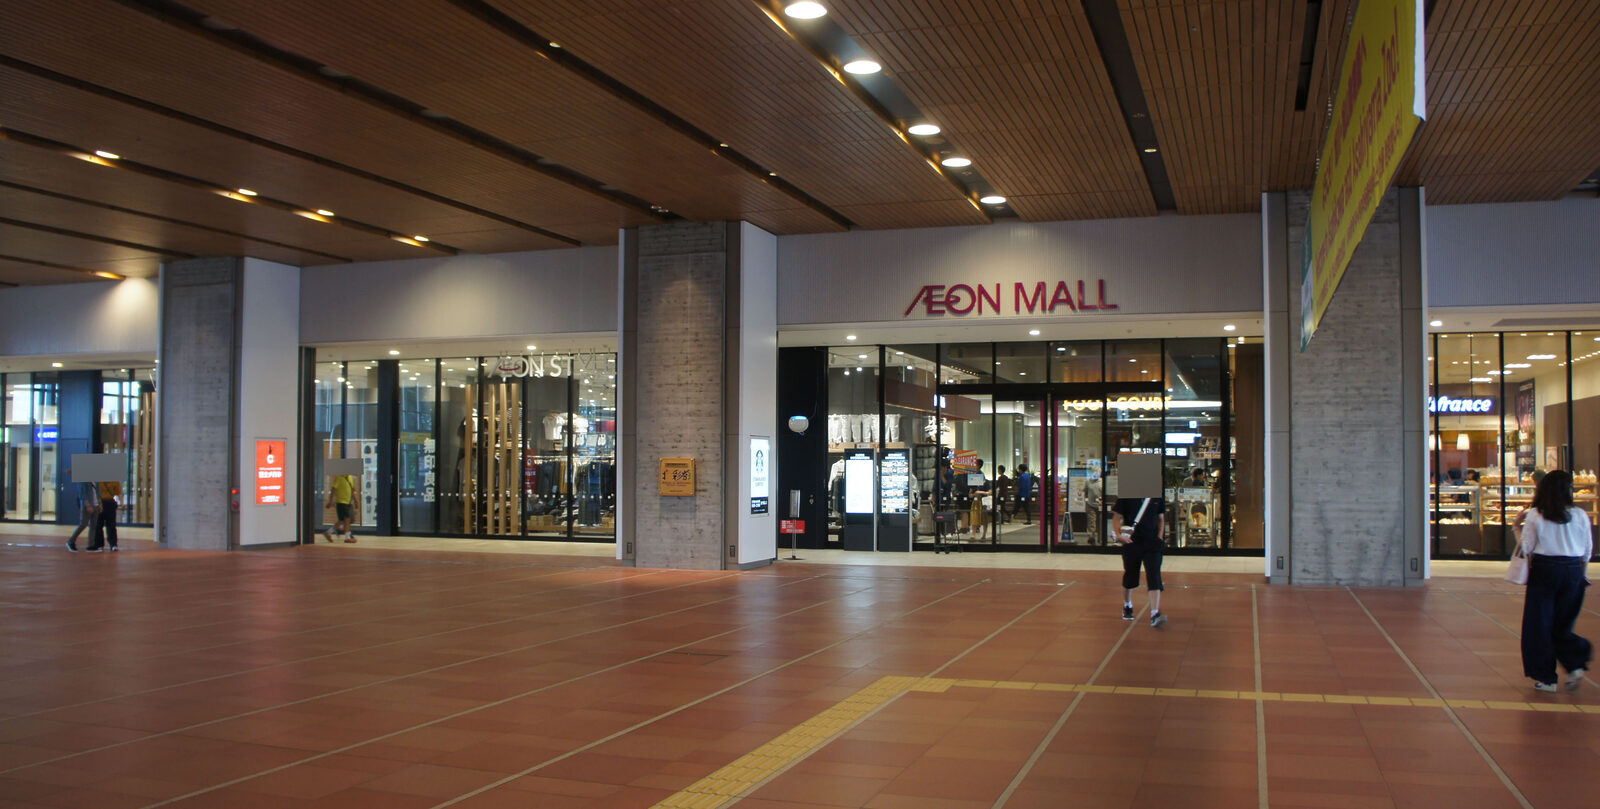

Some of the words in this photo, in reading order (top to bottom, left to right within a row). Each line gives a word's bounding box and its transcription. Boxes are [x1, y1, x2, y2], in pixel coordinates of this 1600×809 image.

[1381, 5, 1400, 107] Zoo!
[1014, 279, 1119, 312] MALL
[1116, 394, 1173, 411] COURT
[423, 437, 436, 503] 無印良品
